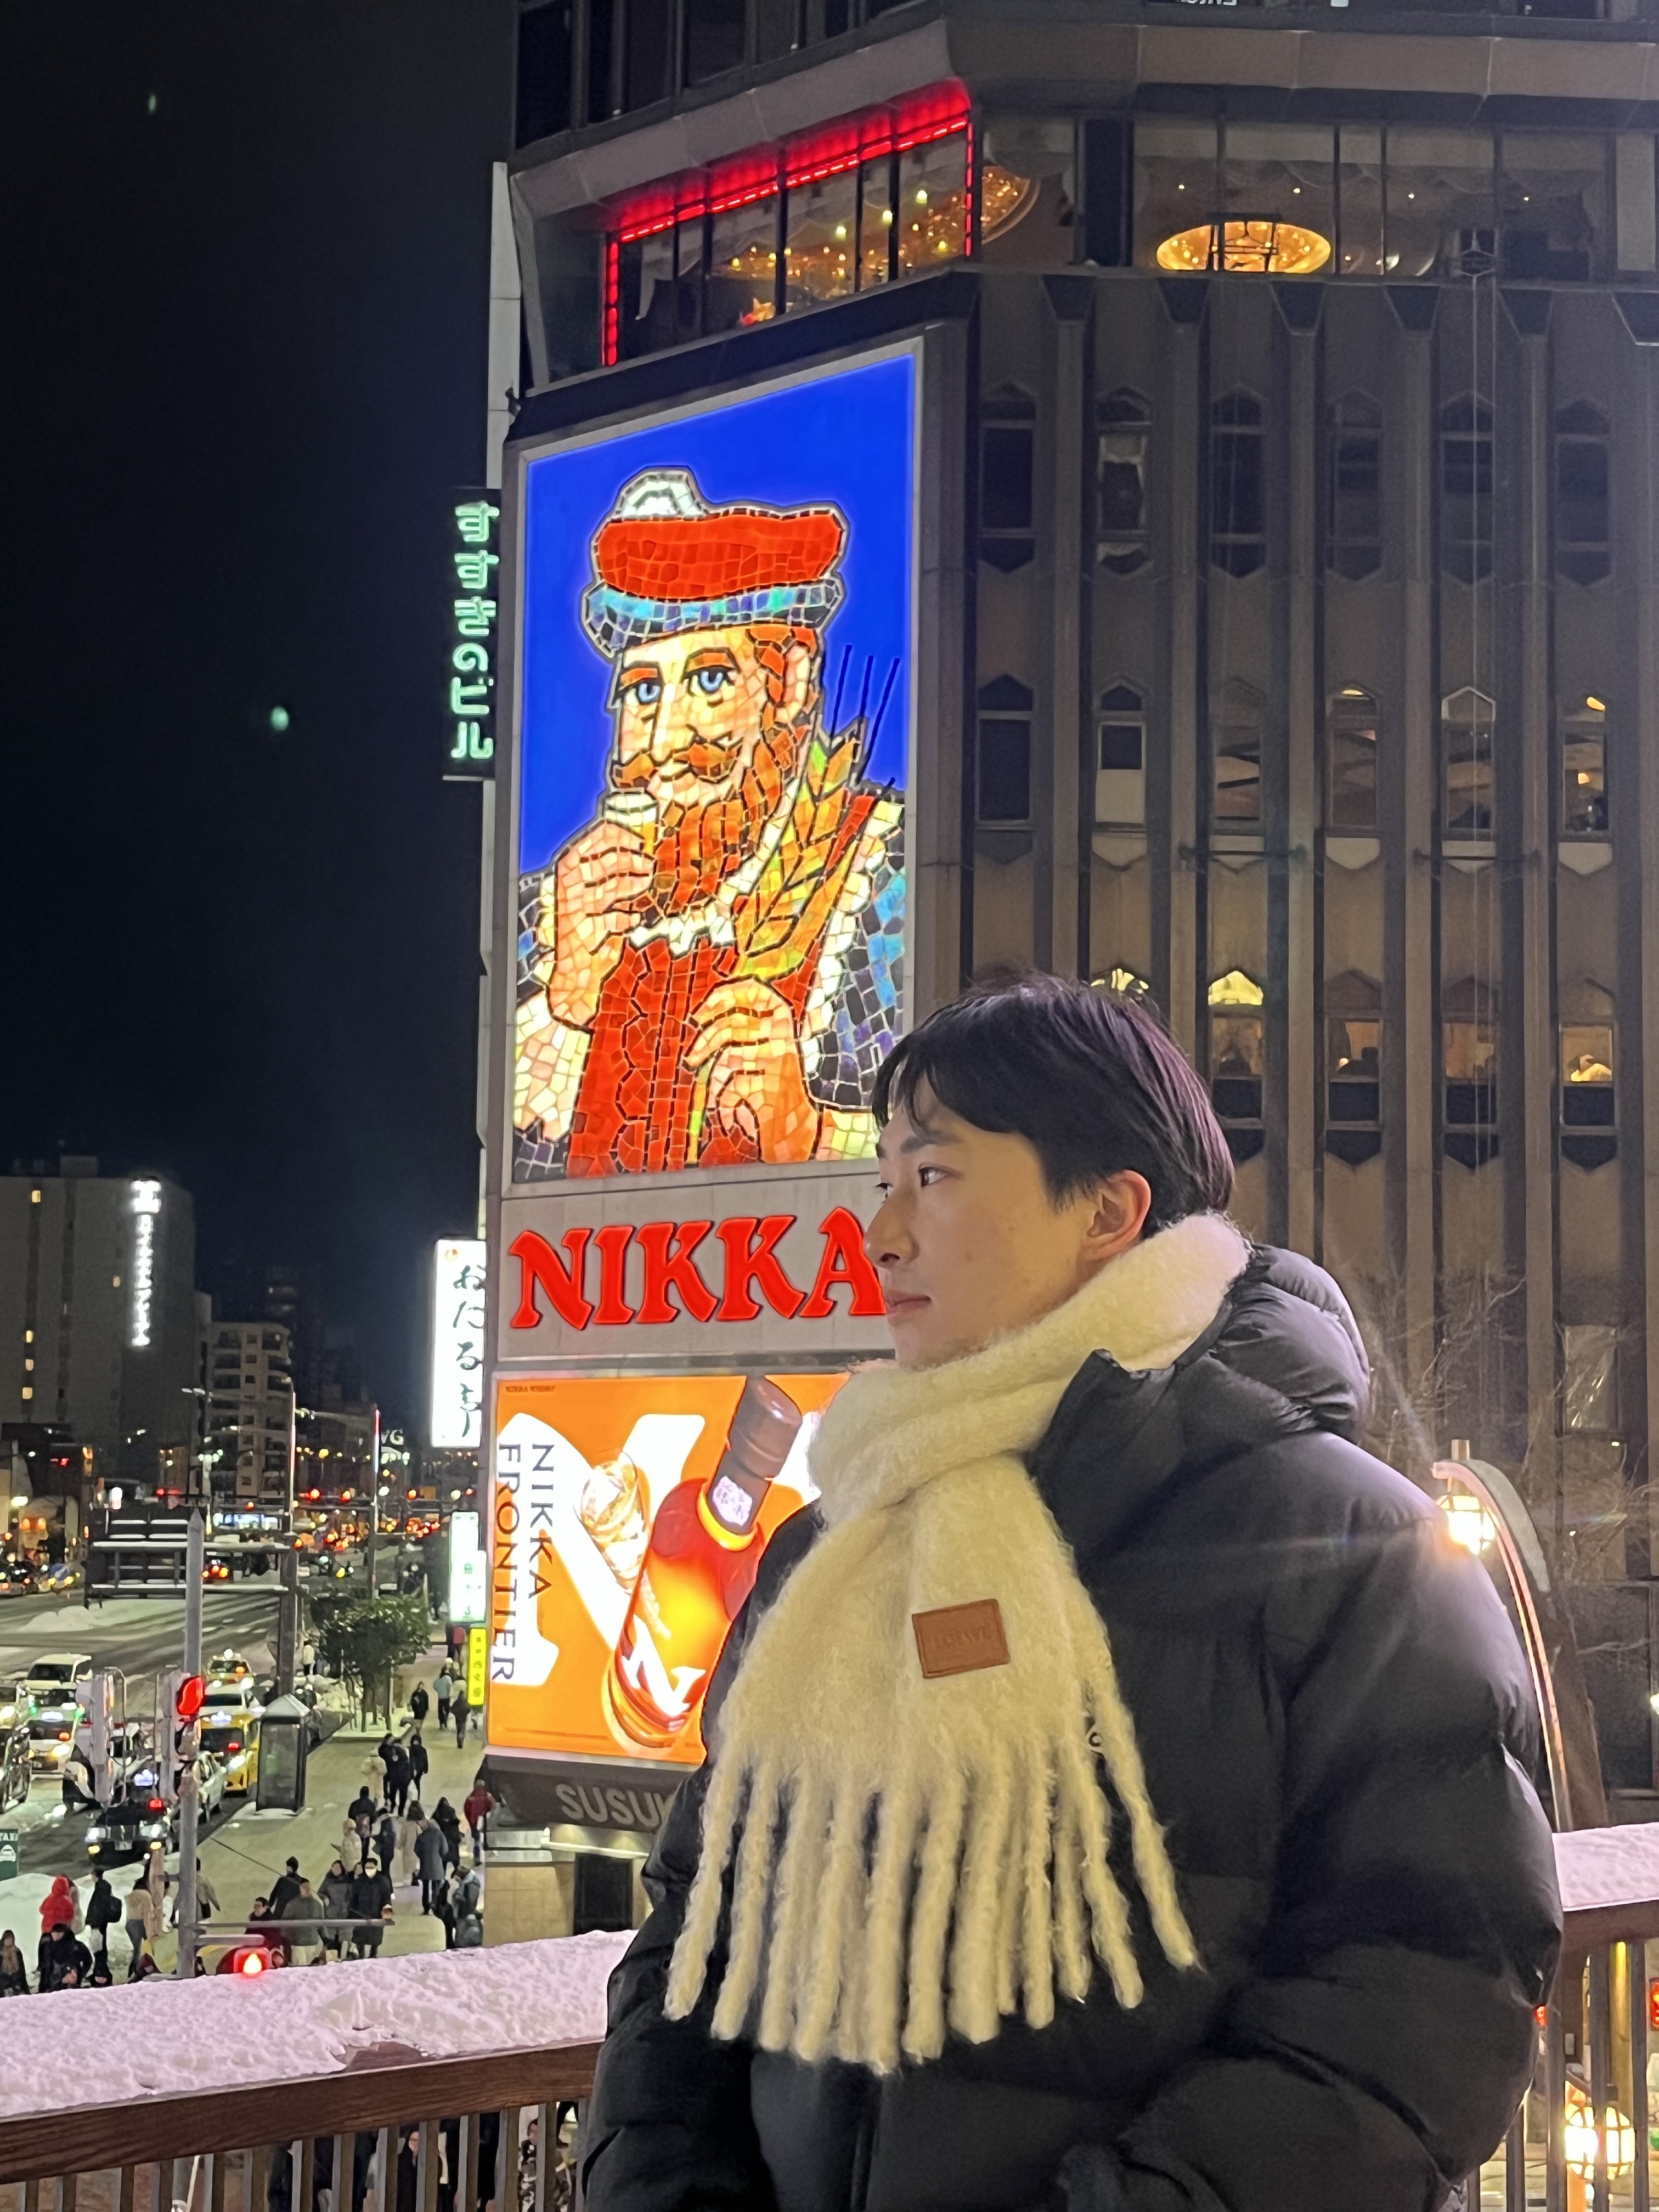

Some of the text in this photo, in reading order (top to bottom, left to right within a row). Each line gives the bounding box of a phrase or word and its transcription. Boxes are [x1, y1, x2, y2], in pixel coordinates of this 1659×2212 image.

[509, 1206, 887, 1330] NIKKA
[492, 1443, 521, 1680] FRONTIER
[528, 1443, 555, 1599] NIKKA
